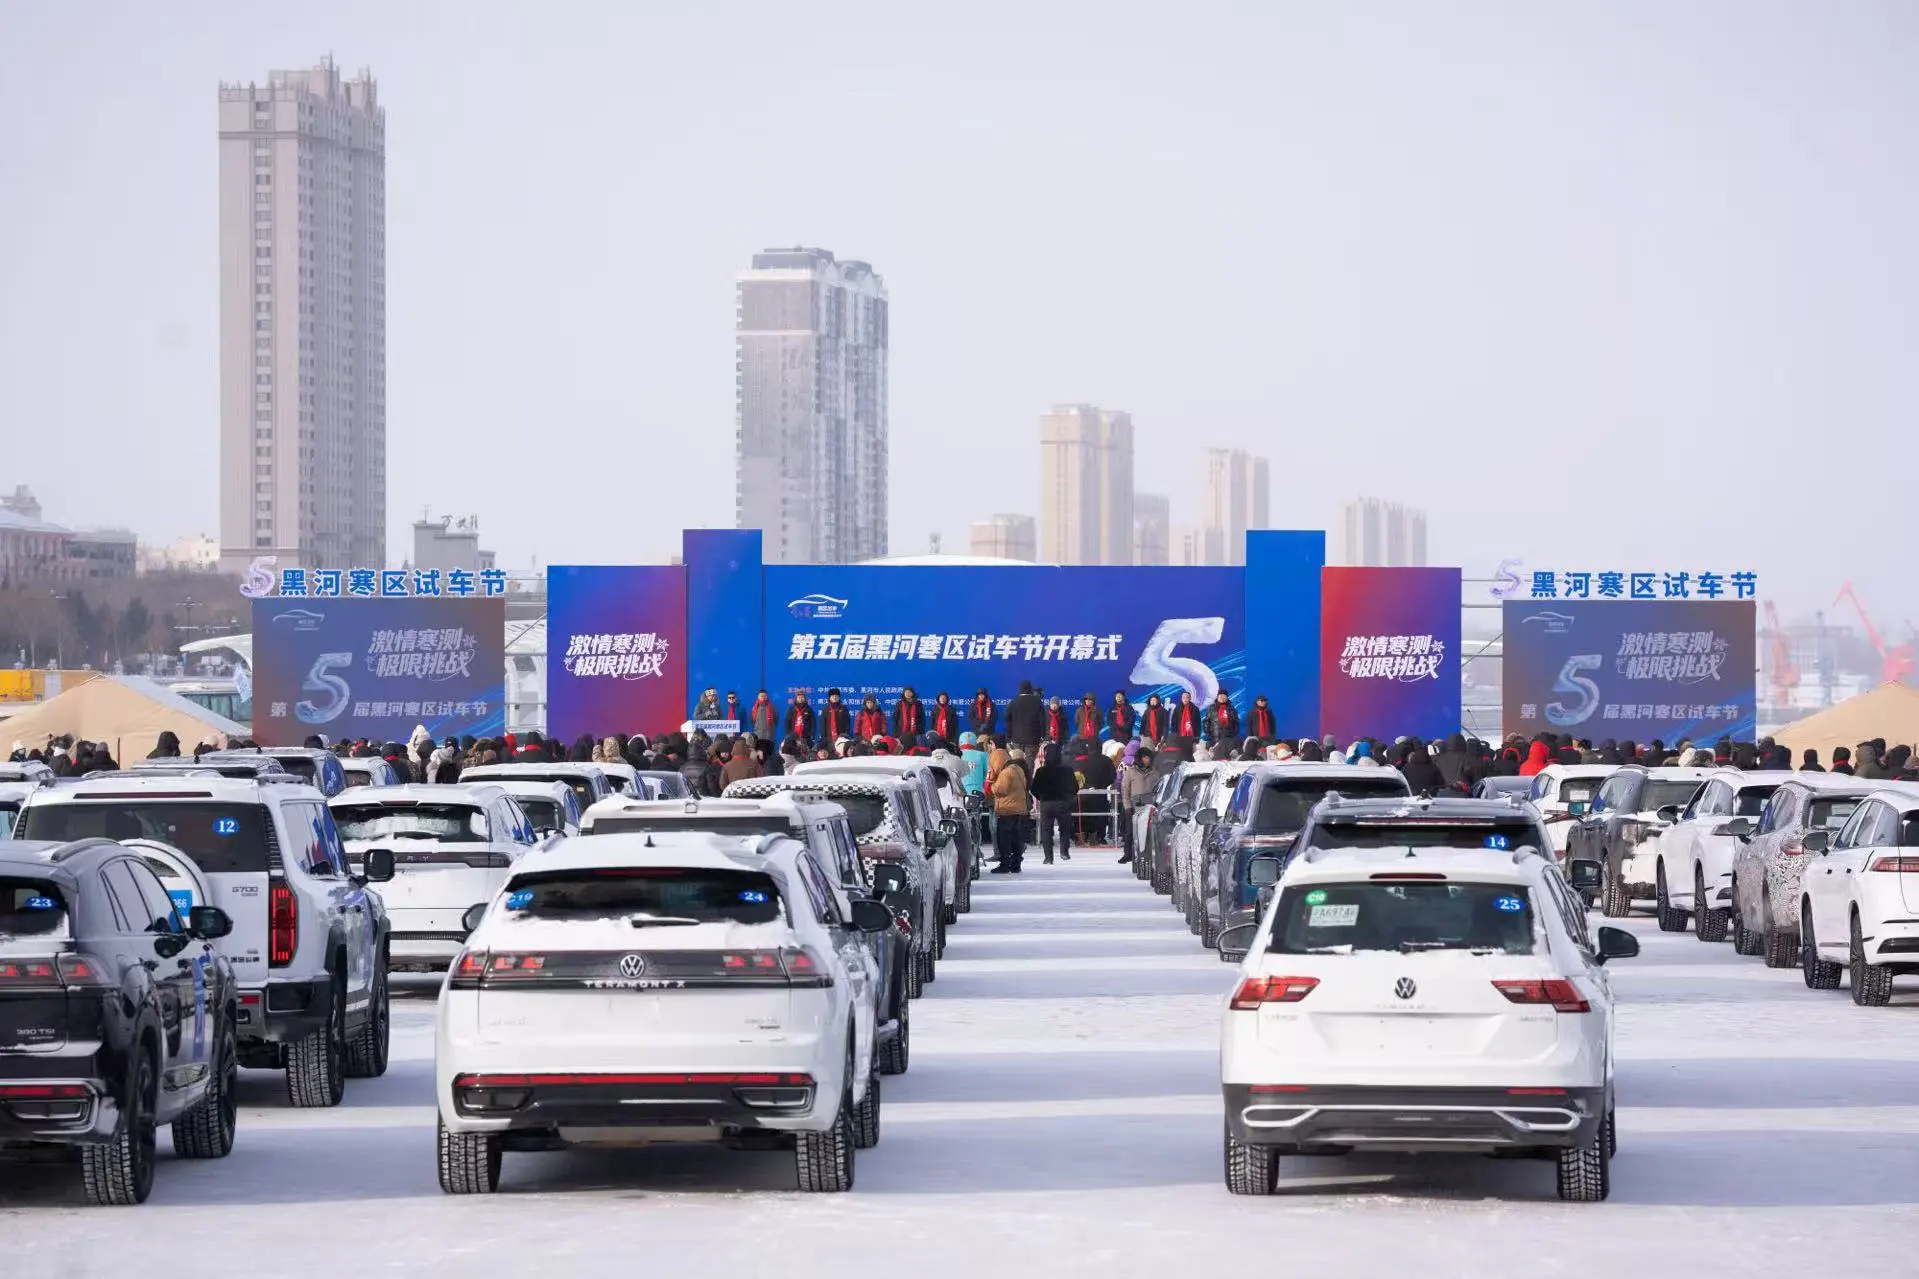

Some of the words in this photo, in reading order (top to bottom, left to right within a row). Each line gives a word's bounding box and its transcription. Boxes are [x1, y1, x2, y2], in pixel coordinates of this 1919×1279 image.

[280, 570, 507, 597] 黑河寒区试车节
[1531, 572, 1757, 599] 黑河寒区试车节
[368, 629, 465, 653] 激情寒测
[566, 633, 656, 656] 激情寒测
[788, 633, 1122, 662] 第五届黑河寒区试车节开幕式
[1341, 635, 1433, 657] 激情寒测
[1618, 631, 1714, 655] 激情寒测
[376, 652, 471, 678] 极限挑战
[575, 654, 663, 678] 极限挑战
[1349, 656, 1440, 680] 极限挑战
[1625, 655, 1722, 681] 极限挑战
[270, 701, 288, 718] 第
[353, 701, 488, 718] 届黑河寒区试车节
[1520, 703, 1537, 720] 第
[1603, 703, 1739, 720] 届黑河寒区试车节
[217, 820, 236, 834] 12
[1489, 836, 1506, 848] 14
[30, 897, 53, 908] 23
[743, 891, 764, 903] 24
[1498, 899, 1520, 910] 25
[583, 980, 670, 988] TERAMONT
[676, 980, 686, 988] X
